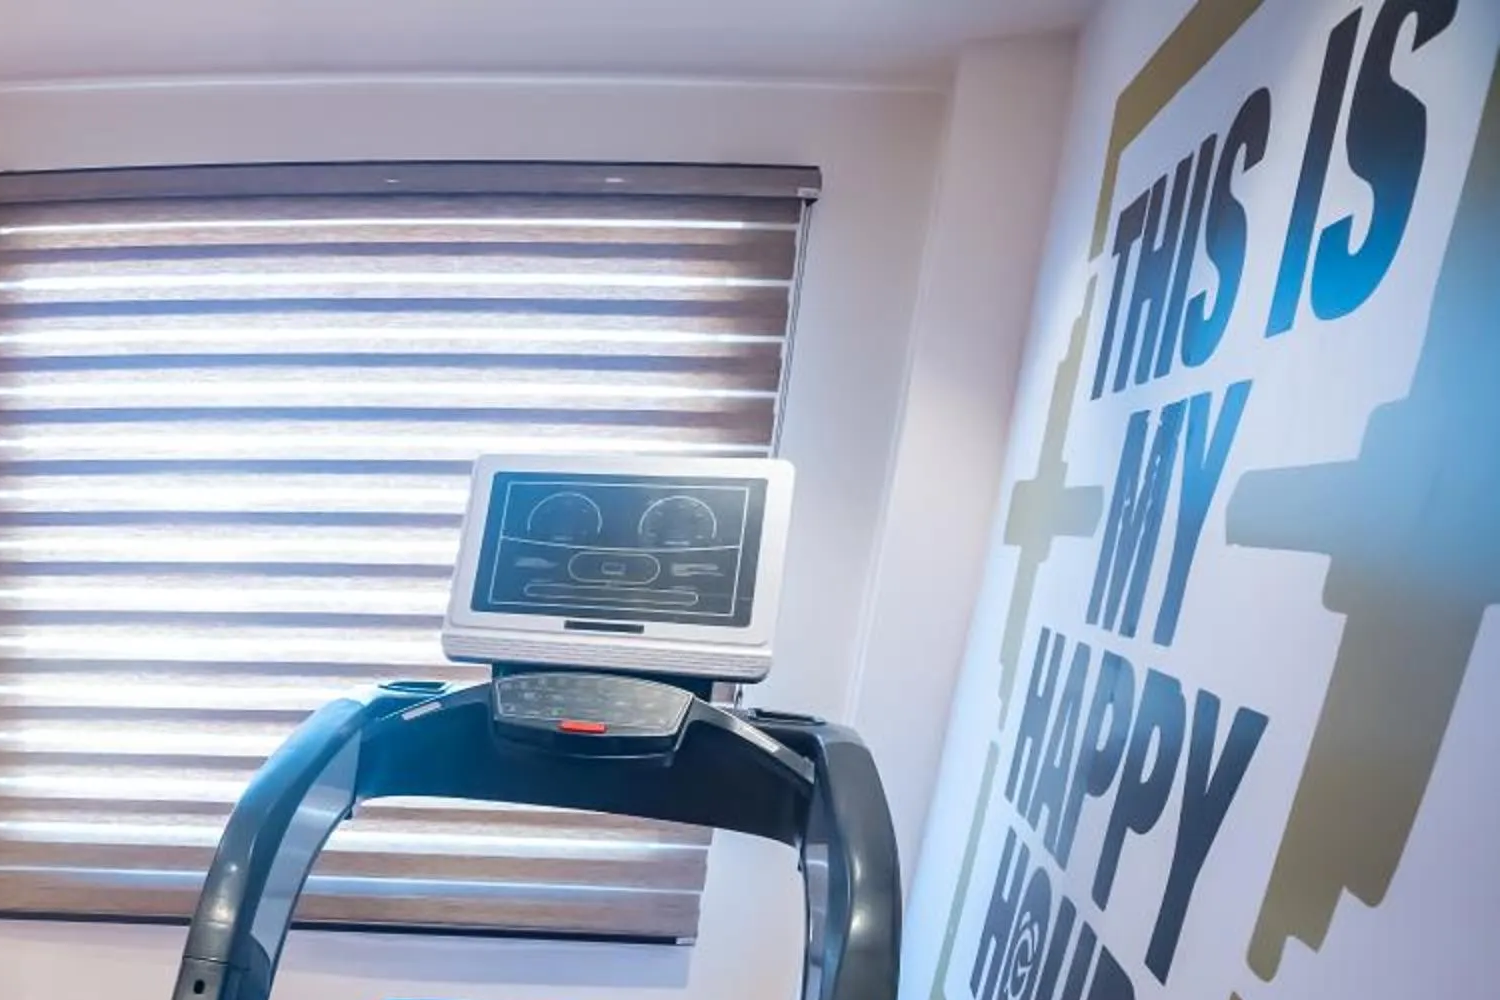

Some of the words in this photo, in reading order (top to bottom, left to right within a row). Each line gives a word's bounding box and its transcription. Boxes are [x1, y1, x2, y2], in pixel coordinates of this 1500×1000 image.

[1090, 87, 1271, 401] THIS
[1265, 0, 1459, 339] IS
[1086, 379, 1253, 648] MY
[1005, 627, 1269, 987] HAPPY
